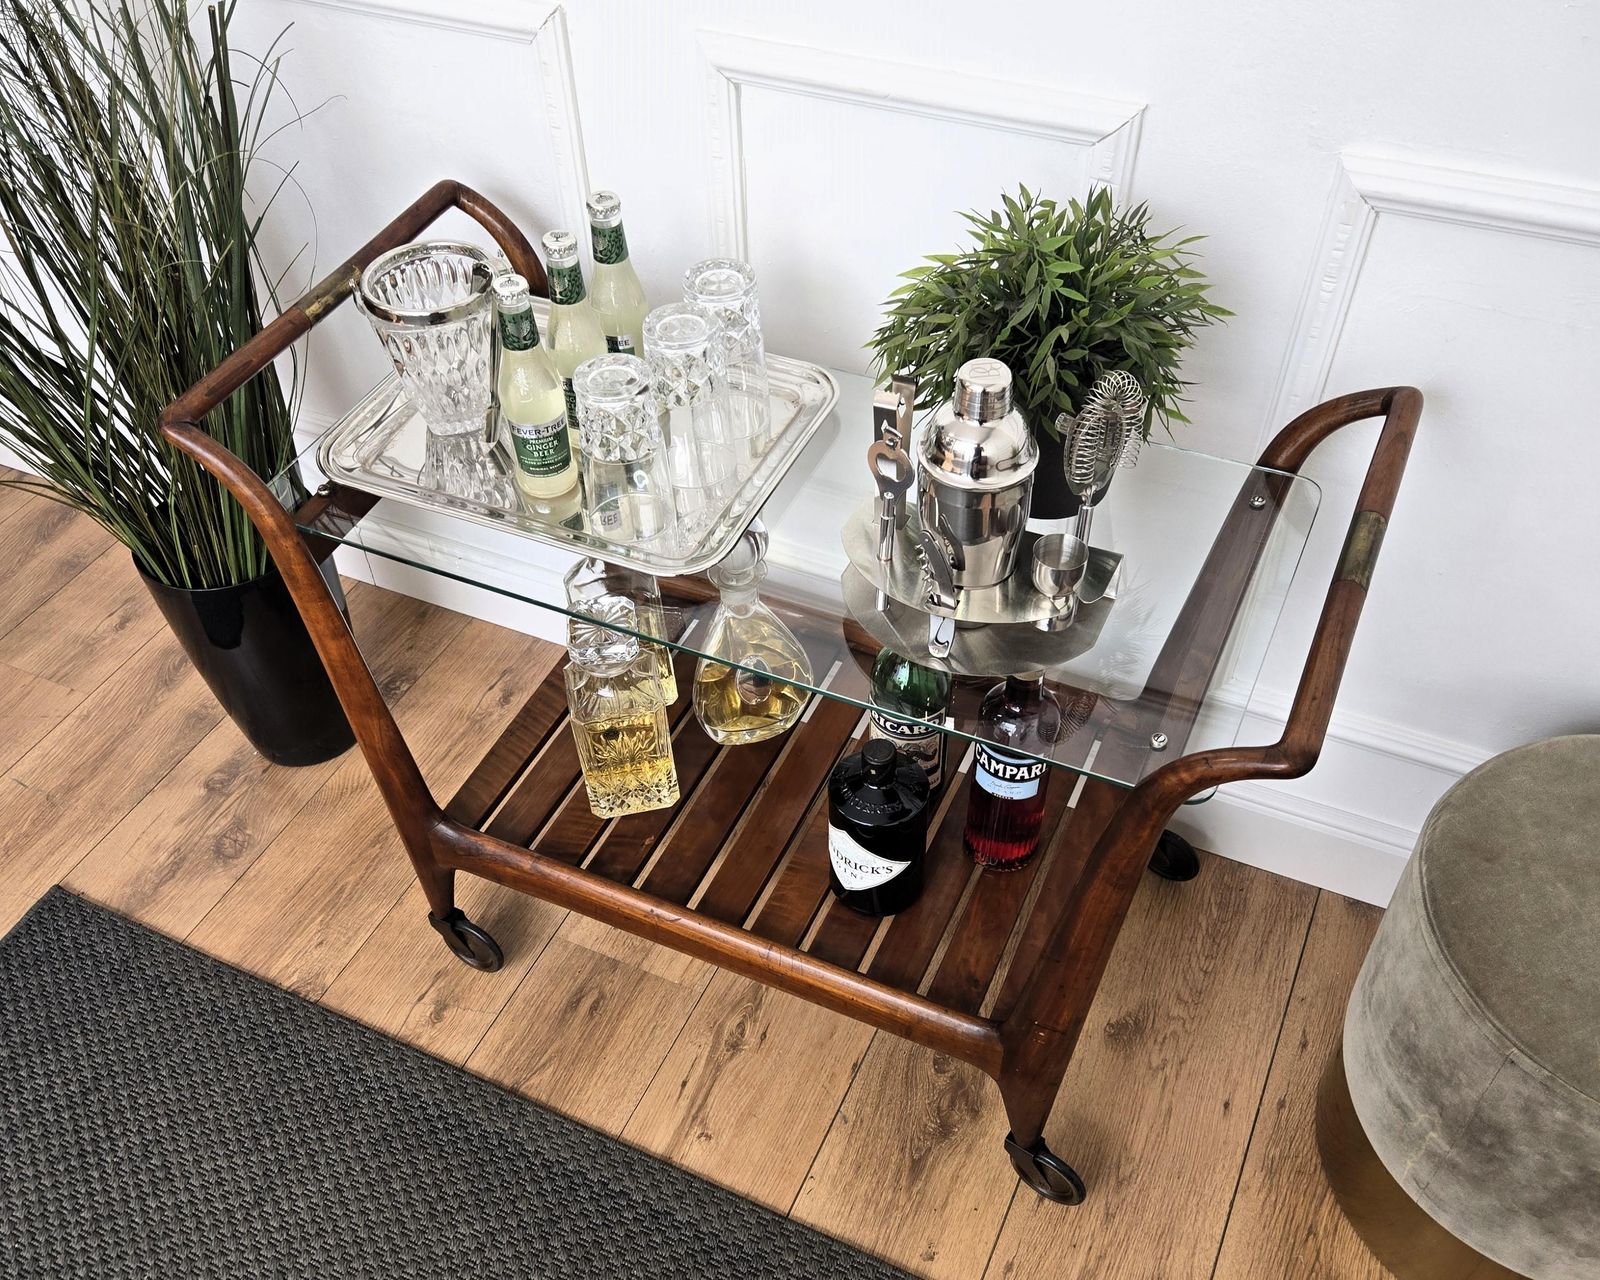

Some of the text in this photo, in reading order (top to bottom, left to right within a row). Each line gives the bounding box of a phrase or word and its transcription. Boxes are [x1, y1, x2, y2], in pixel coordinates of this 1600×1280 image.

[511, 417, 565, 436] FEVER-TREE
[525, 440, 559, 452] GINGER
[533, 448, 555, 458] BEER
[975, 743, 1048, 780] CAMPARI
